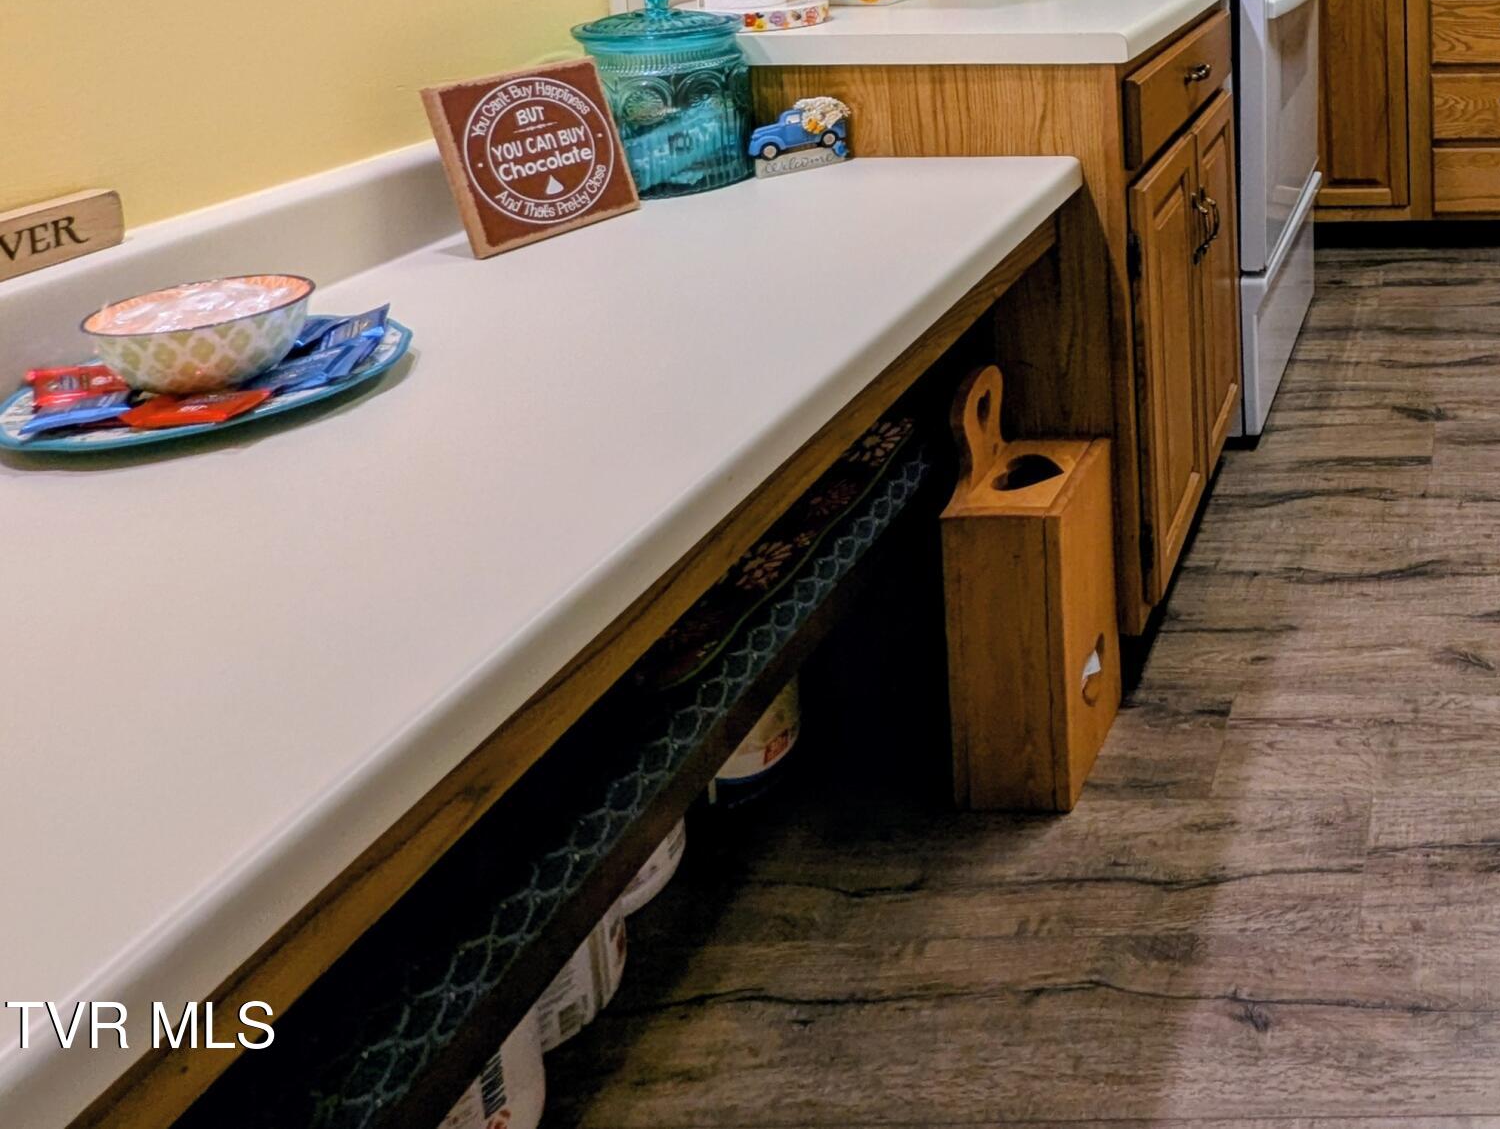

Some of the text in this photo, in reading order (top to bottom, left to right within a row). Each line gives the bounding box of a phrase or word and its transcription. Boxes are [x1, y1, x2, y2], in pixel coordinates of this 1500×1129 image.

[471, 82, 590, 138] You Can't Buy Happiness
[515, 106, 545, 126] BUT
[491, 125, 587, 163] YOU CAN BUY
[498, 146, 593, 183] Chocolate
[495, 164, 607, 219] And That's Pretty Close
[0, 216, 90, 261] VER
